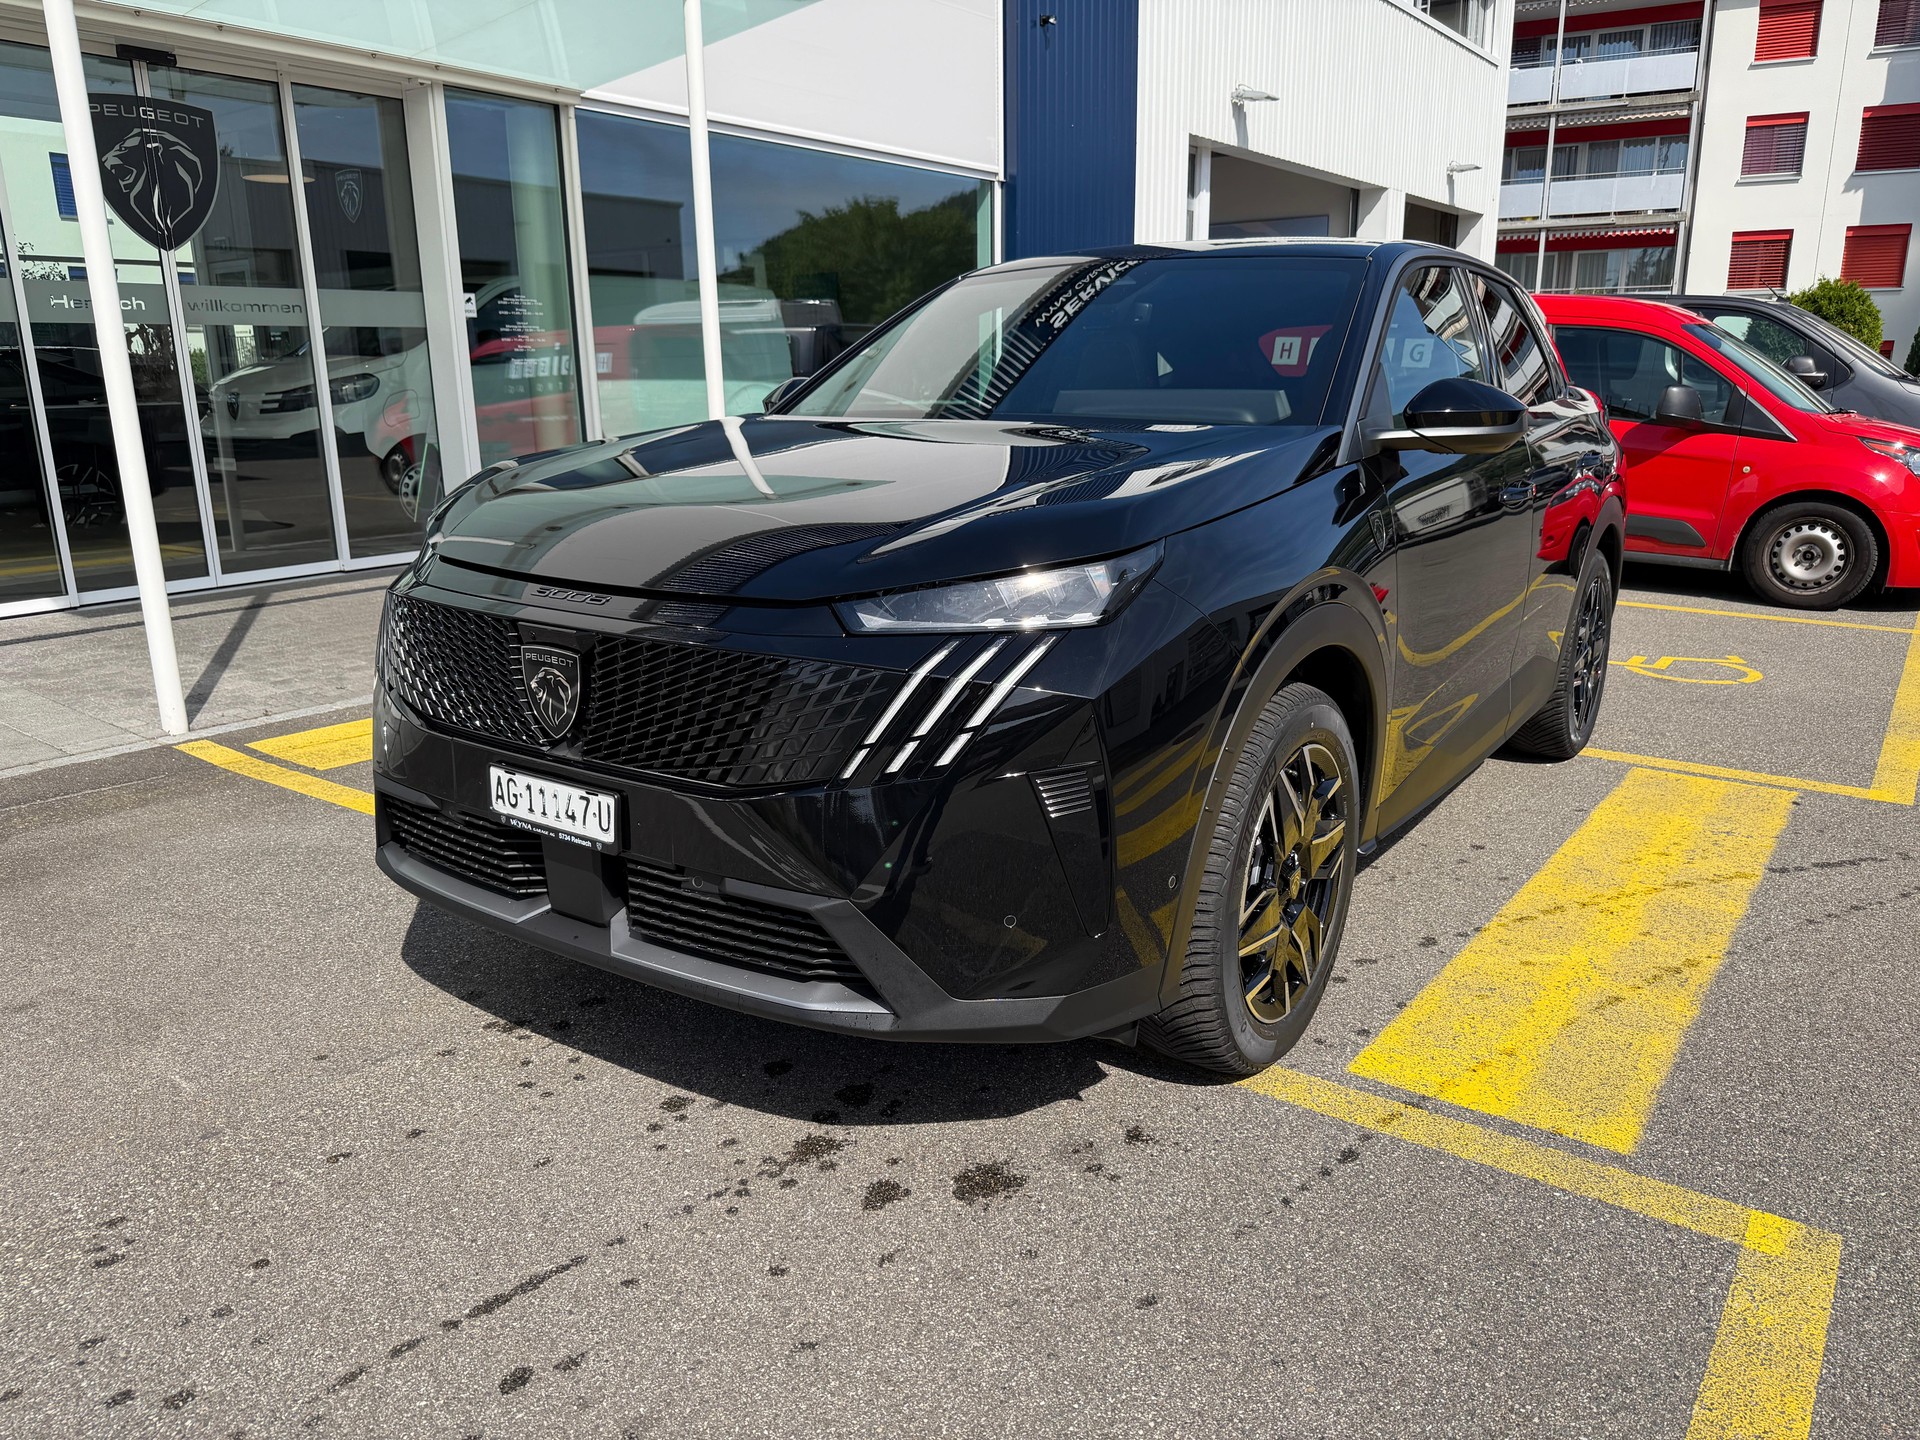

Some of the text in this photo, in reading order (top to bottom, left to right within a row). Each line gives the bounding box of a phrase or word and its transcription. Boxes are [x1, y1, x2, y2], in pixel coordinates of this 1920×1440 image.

[90, 103, 204, 128] PEUGEOT
[50, 294, 303, 314] Herch willkommen
[530, 586, 613, 606] 3008
[525, 652, 574, 667] PEUGEOT
